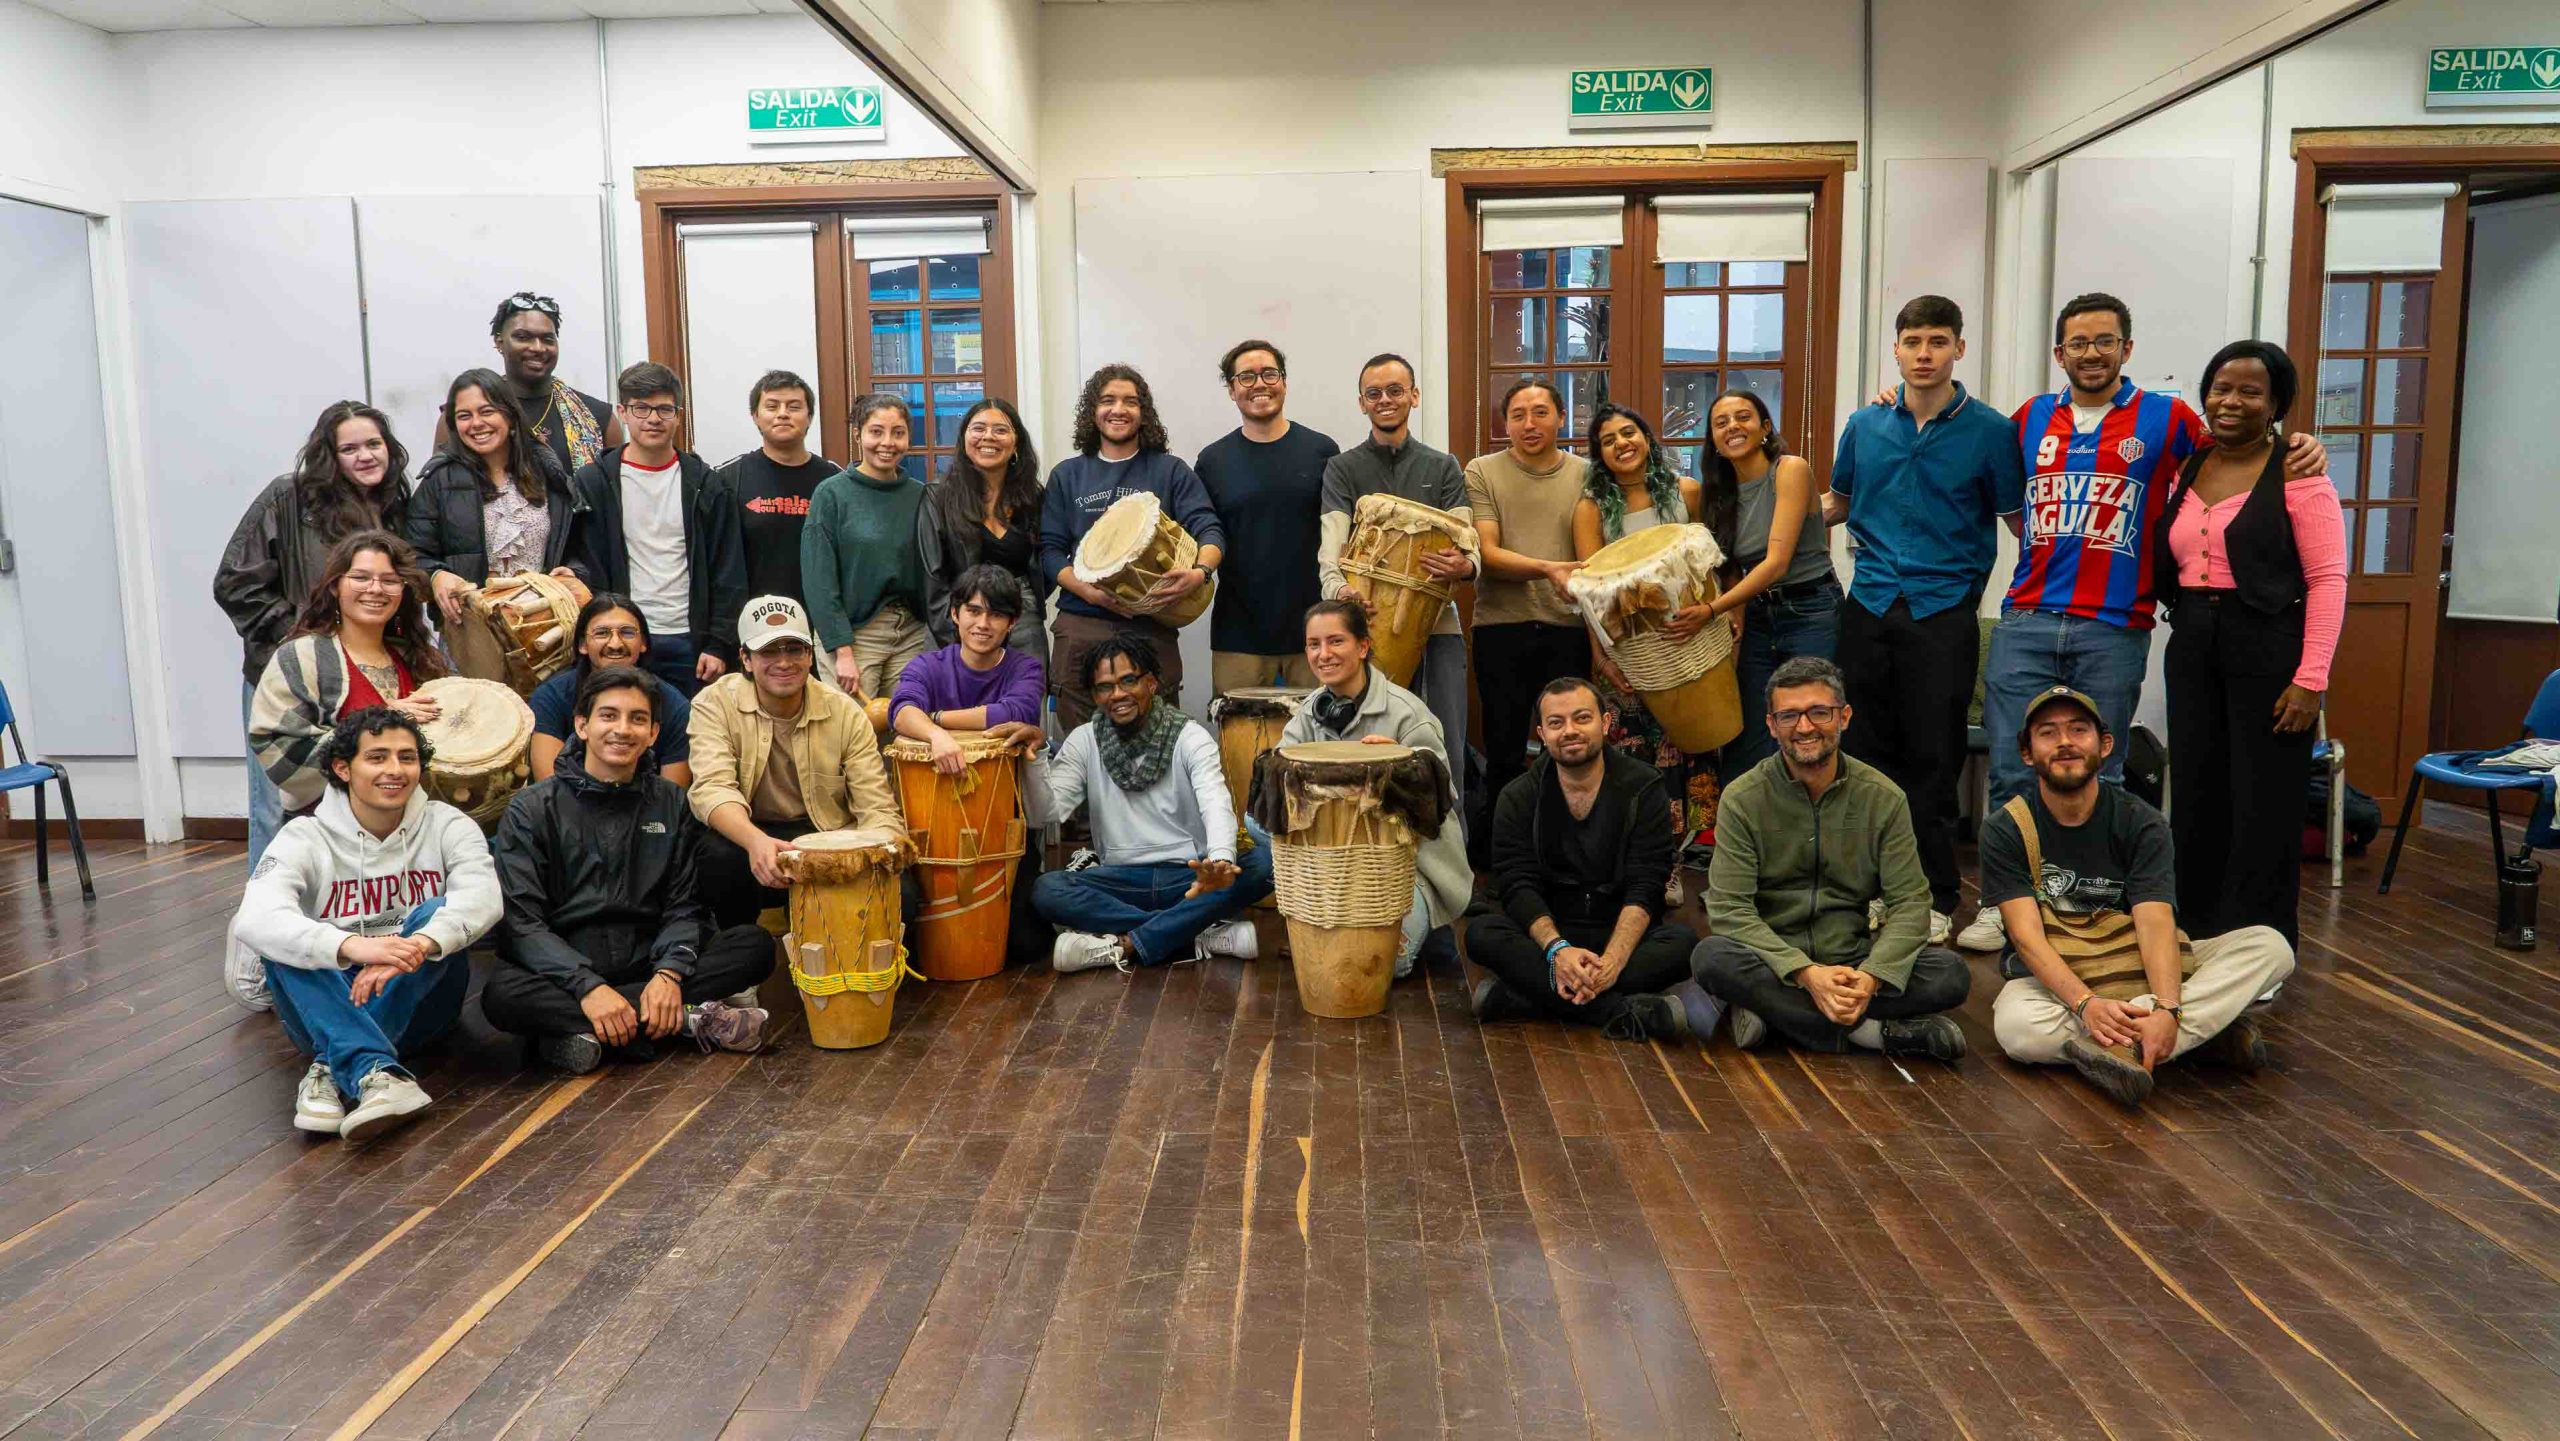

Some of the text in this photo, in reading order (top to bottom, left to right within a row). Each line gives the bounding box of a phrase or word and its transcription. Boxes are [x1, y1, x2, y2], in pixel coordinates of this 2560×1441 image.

[2432, 50, 2528, 71] SALIDA
[1574, 72, 1668, 94] SALIDA
[2457, 71, 2503, 90] Exit
[750, 89, 840, 110] SALIDA
[1600, 93, 1644, 111] Exit
[776, 109, 818, 127] Exit
[2037, 435, 2060, 466] 9
[1075, 489, 1113, 507] Tommy
[2026, 475, 2137, 512] CERVEZA
[2029, 503, 2128, 543] AGUILA
[319, 870, 442, 919] NEWPORT
